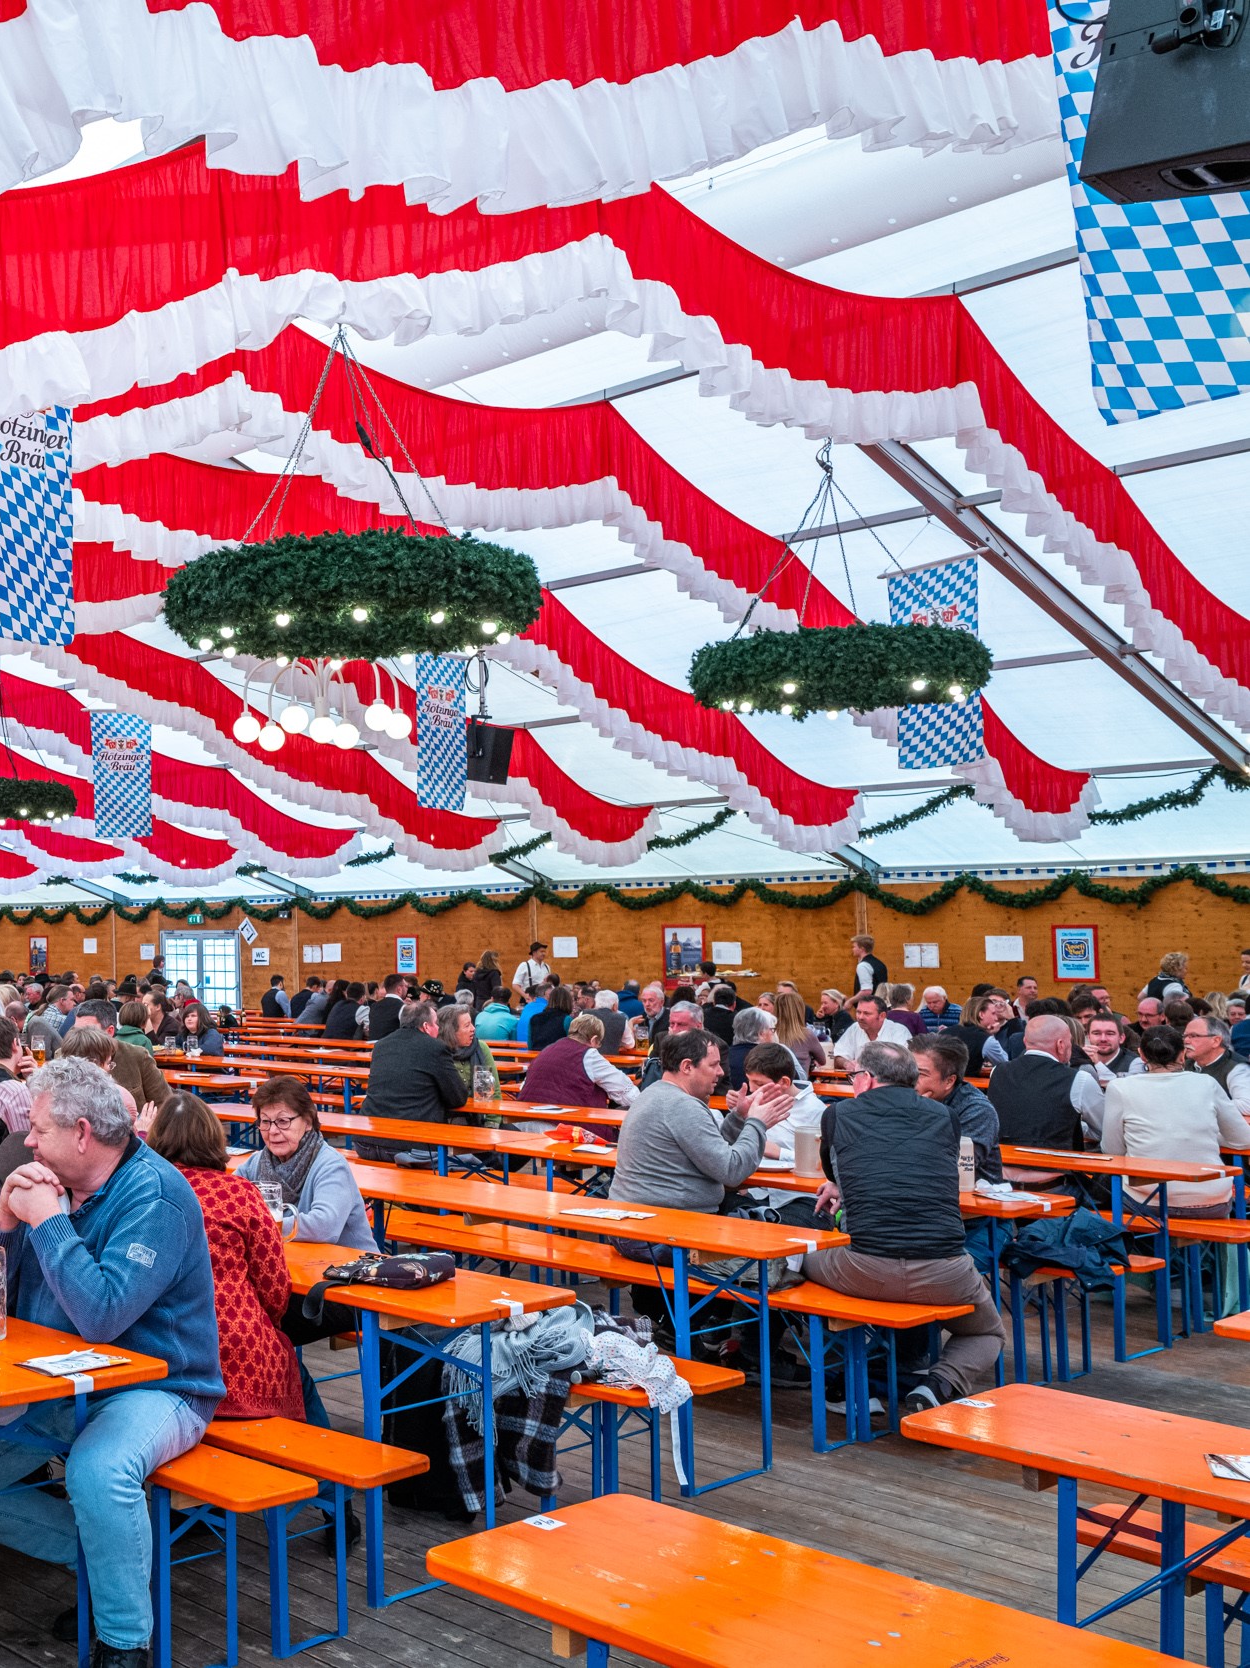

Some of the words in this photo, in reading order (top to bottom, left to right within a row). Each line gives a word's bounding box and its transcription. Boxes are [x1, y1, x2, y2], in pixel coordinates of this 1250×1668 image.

[431, 715, 452, 728] Bräu
[98, 752, 145, 762] Flötzinger
[108, 761, 136, 771] Bräu
[255, 951, 266, 959] WC
